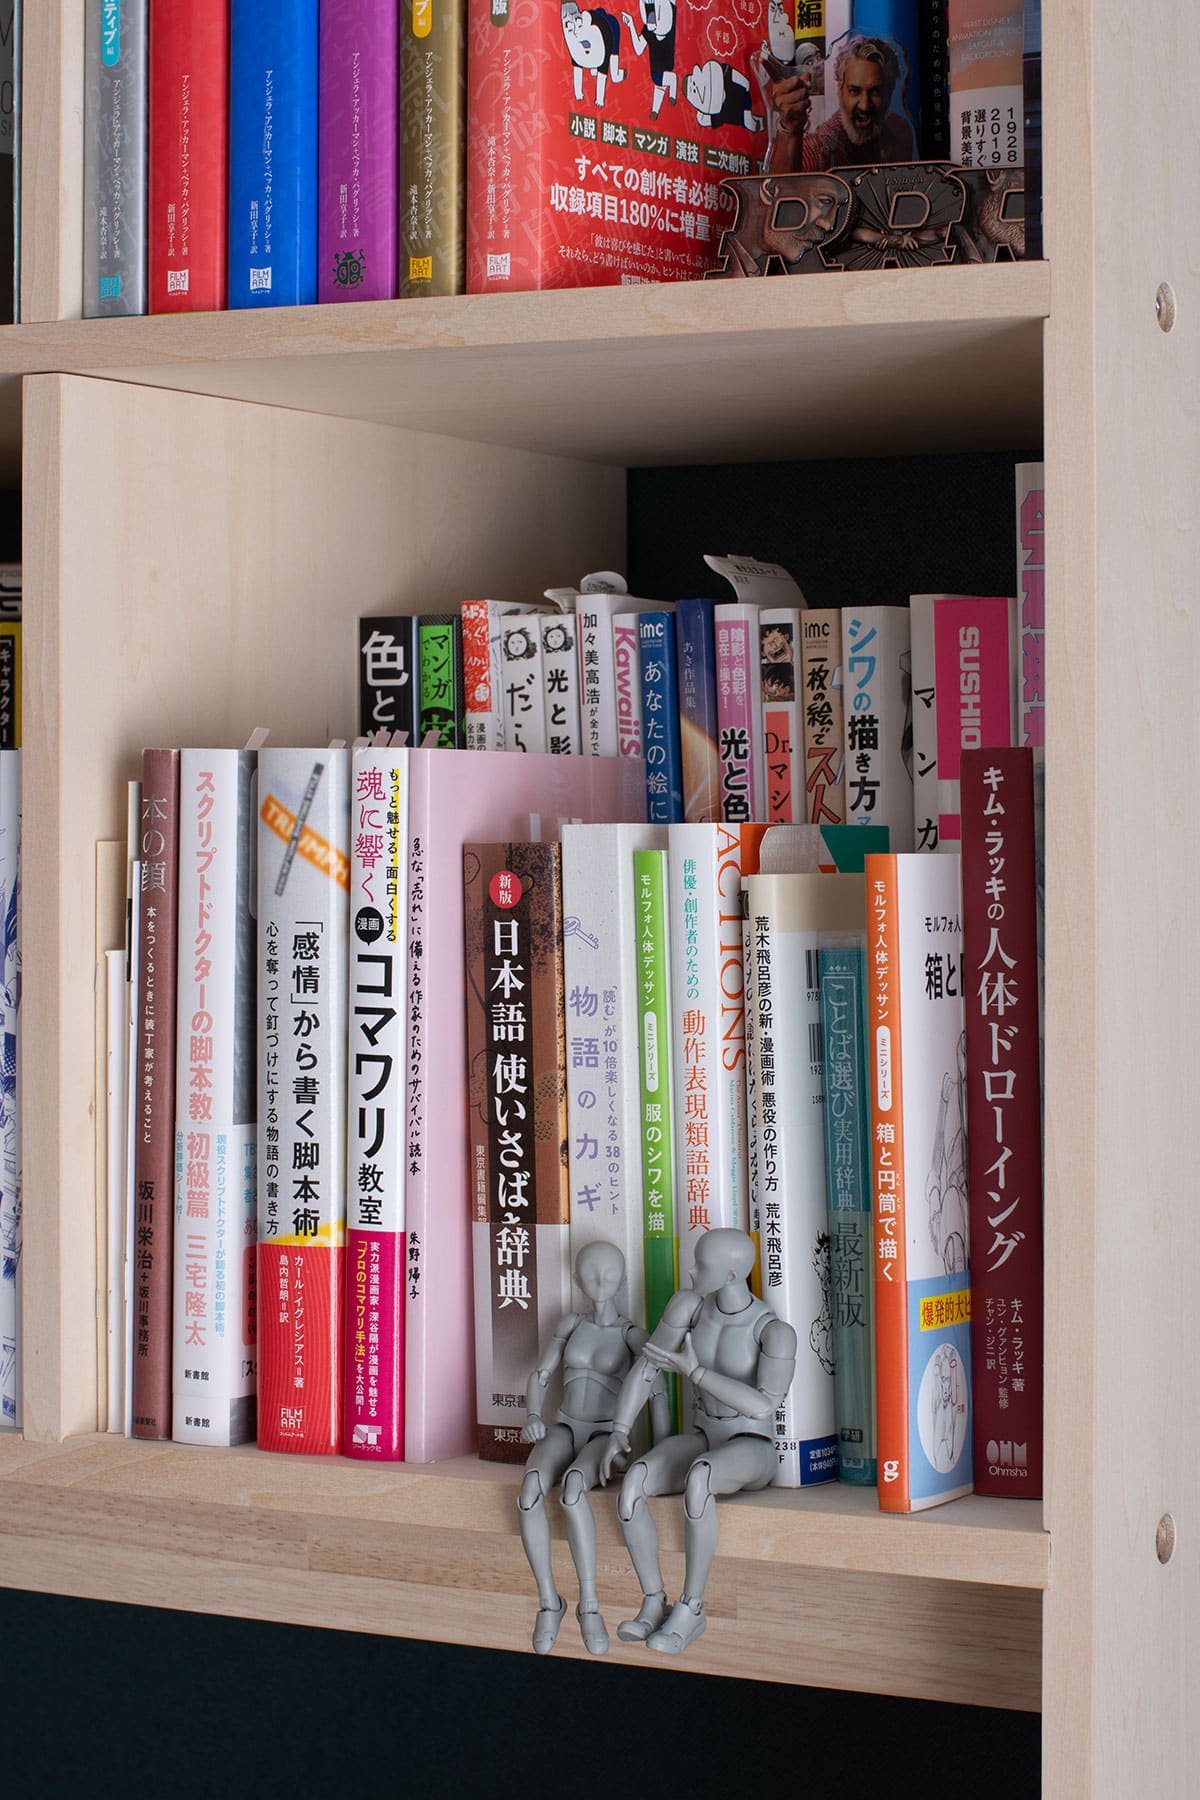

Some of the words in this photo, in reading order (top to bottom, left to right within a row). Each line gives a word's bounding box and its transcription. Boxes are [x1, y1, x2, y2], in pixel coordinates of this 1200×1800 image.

[571, 115, 597, 140] 小説
[602, 122, 628, 146] 脚本
[634, 132, 669, 155] マンガ
[675, 139, 699, 164] 演技
[706, 149, 750, 176] 二次創作
[990, 107, 1001, 164] 2019
[1006, 107, 1018, 163] 1928
[550, 182, 711, 242] 収録項目180%に増量
[169, 281, 186, 289] ART
[170, 272, 187, 281] FILM
[252, 271, 270, 279] FILM
[252, 279, 269, 287] ART
[489, 256, 508, 265] FILM
[489, 264, 508, 273] ART
[640, 623, 664, 638] imc
[804, 622, 830, 637] imc
[429, 633, 452, 701] マンガ
[583, 613, 600, 756] 加々美高浩が全力で
[959, 626, 981, 750] SUSHIO
[644, 661, 668, 821] あなたの絵に
[355, 766, 387, 903] 魂に響く
[386, 768, 400, 943] もっと魅せる・面白くする
[499, 874, 513, 905] 新版
[187, 771, 218, 1121] スクリプトドクターの脚本教
[357, 917, 380, 931] 漫画
[640, 874, 656, 1007] モルフォ人体デッサン
[683, 858, 700, 1000] 俳優・創作者のための
[873, 880, 889, 1020] モルフォ人体デッサン
[408, 837, 425, 1176] 急な「売れ」に備える作家のためのサバイバル読本
[755, 916, 775, 1086] 荒木飛呂彦の新・漫画術
[925, 952, 964, 1000] 箱と
[265, 920, 279, 1236] 心を奪って釘づけにする物語の書き方
[291, 920, 324, 1237] 「感情」から書く脚本術
[647, 1023, 656, 1081] ミニシリーズ
[880, 1037, 889, 1099] ミニシリーズ
[354, 953, 397, 1226] コマワリ教室
[568, 985, 602, 1213] 物語のカギ
[682, 1009, 710, 1233] 動作表現類語辞典
[645, 1102, 665, 1238] 服のシワを描
[761, 1092, 779, 1192] 悪役の作り方
[876, 1122, 898, 1282] 箱と円筒で描く
[766, 1202, 783, 1287] 荒木飛呂彦
[833, 1221, 867, 1329] 最新版
[184, 1369, 210, 1381] 新書館
[185, 1416, 211, 1428] 新書館
[281, 1407, 303, 1419] FILM
[281, 1418, 302, 1429] ART
[988, 1465, 1028, 1478] Ohmsha
